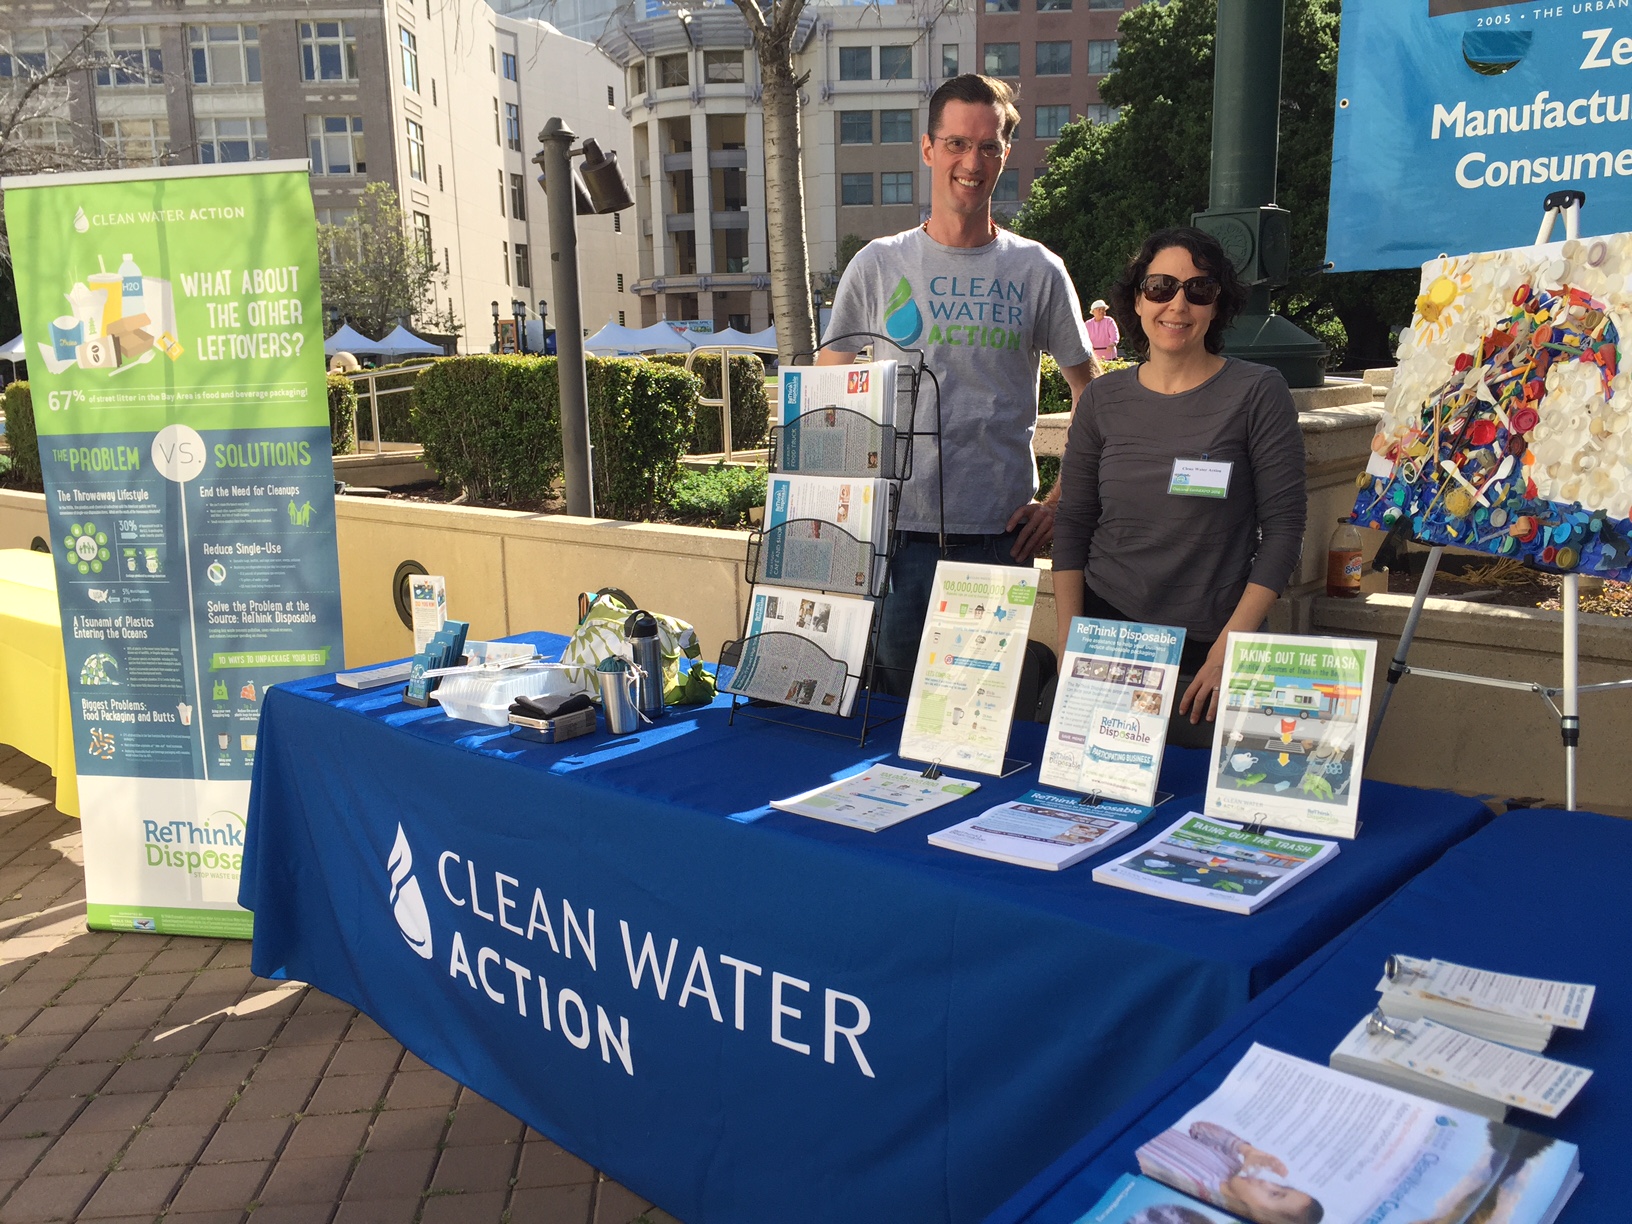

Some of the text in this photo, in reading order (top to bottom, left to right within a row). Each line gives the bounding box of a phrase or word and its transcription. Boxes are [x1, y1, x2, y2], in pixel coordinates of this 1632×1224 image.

[1477, 0, 1629, 27] 2005 THE URBAN
[1455, 149, 1632, 189] Consume
[93, 207, 244, 226] CLEAN WATER ACTION
[122, 282, 140, 293] H2O
[180, 266, 299, 297] WHAT ABOUT
[930, 277, 1024, 302] CLEAN
[207, 299, 303, 328] THE OTHER
[929, 301, 1022, 326] WATER
[928, 324, 1021, 350] ACTION
[197, 333, 304, 361] LEFTOVERS?
[48, 390, 85, 411] 67%
[161, 392, 174, 402] Bay
[176, 391, 193, 400] Area
[202, 390, 219, 399] food
[221, 390, 234, 398] and
[235, 389, 268, 399] beverage
[270, 388, 308, 398] packaging!
[52, 446, 140, 471] THE PROBLEM
[214, 441, 311, 468] SOLUTIONS
[57, 489, 148, 502] The Throwaway Lifestyle
[200, 485, 300, 497] End the Need for Cleanups
[119, 521, 137, 531] 30%
[204, 542, 281, 555] Reduce Single-Use
[208, 600, 309, 612] Solve the Problem at the
[74, 616, 154, 627] A Tsunami of Plastics
[208, 612, 316, 625] Source: ReThink Disposable
[74, 628, 148, 640] Entering the Oceans
[1077, 624, 1176, 644] ReThink Disposable
[256, 654, 290, 662] UNPACKAGE
[1131, 648, 1155, 657] packaging
[1240, 648, 1271, 662] TAKING
[1275, 652, 1295, 664] OUT
[1300, 653, 1316, 666] THE
[82, 698, 147, 711] Biggest Problems:
[83, 711, 175, 723] Food Packaging and Butts
[1102, 717, 1137, 732] ReThink
[1099, 726, 1150, 743] Disposable
[1092, 748, 1151, 764] PARTICIPATING BUSINESS
[1031, 793, 1078, 805] ReThink
[143, 820, 243, 846] ReThink
[1193, 821, 1226, 836] TAKING
[1228, 829, 1251, 840] OUT
[1252, 834, 1273, 847] THE
[438, 850, 875, 1078] CLEAN WATER
[450, 931, 634, 1076] ACTION
